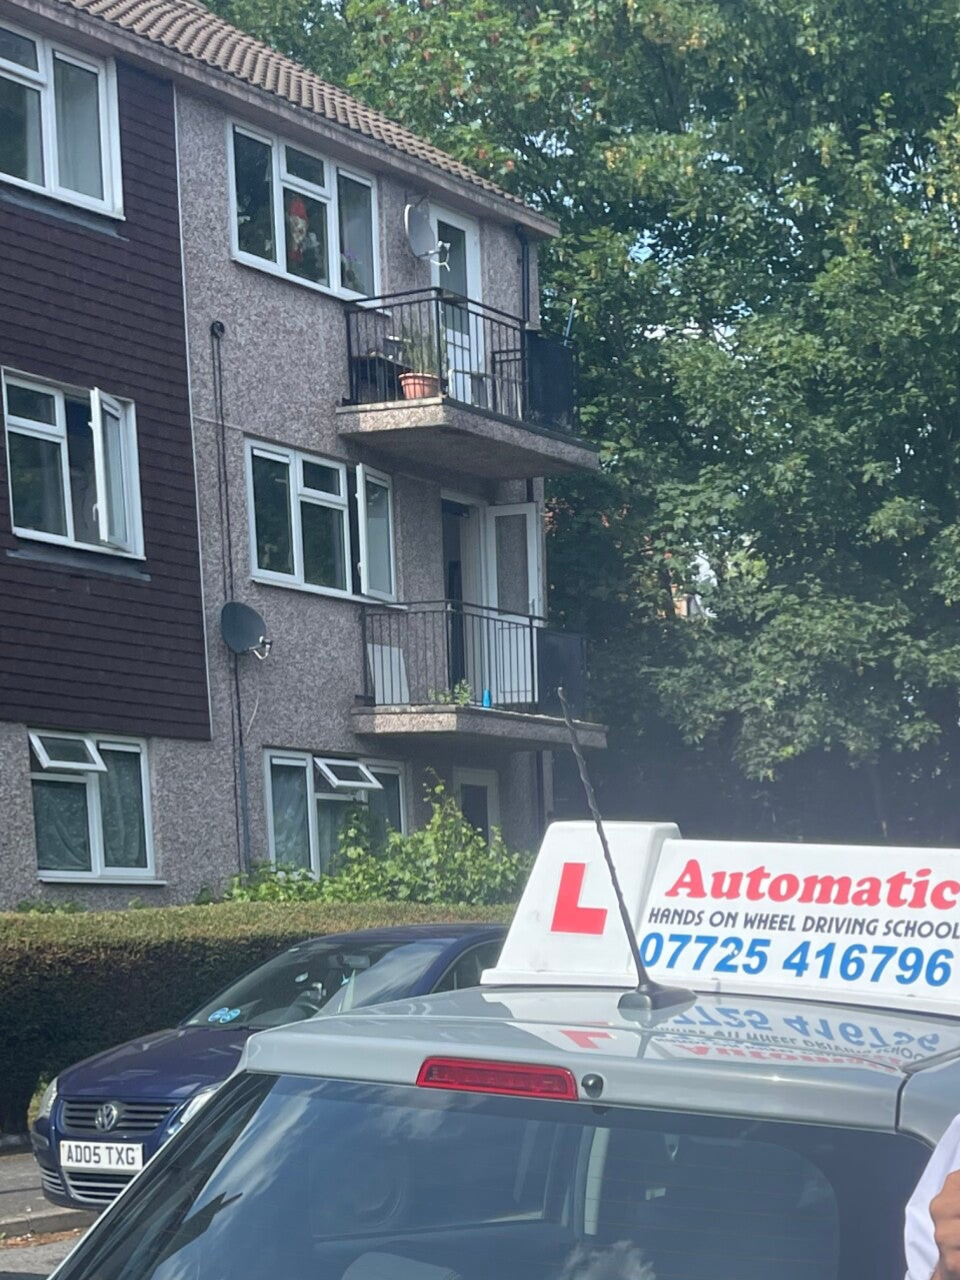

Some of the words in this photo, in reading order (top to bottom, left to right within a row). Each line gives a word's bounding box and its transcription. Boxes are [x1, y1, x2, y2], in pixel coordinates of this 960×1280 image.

[551, 862, 608, 935] L
[665, 859, 960, 910] Automatic
[648, 907, 704, 926] HANDS
[709, 911, 739, 929] ON
[743, 911, 796, 932] WHEEL
[802, 915, 879, 936] DRIVING
[883, 919, 960, 940] SCHOOL
[640, 932, 771, 975] 07725
[782, 941, 955, 987] 416796
[67, 1145, 101, 1163] AD05
[106, 1147, 135, 1166] TXG
